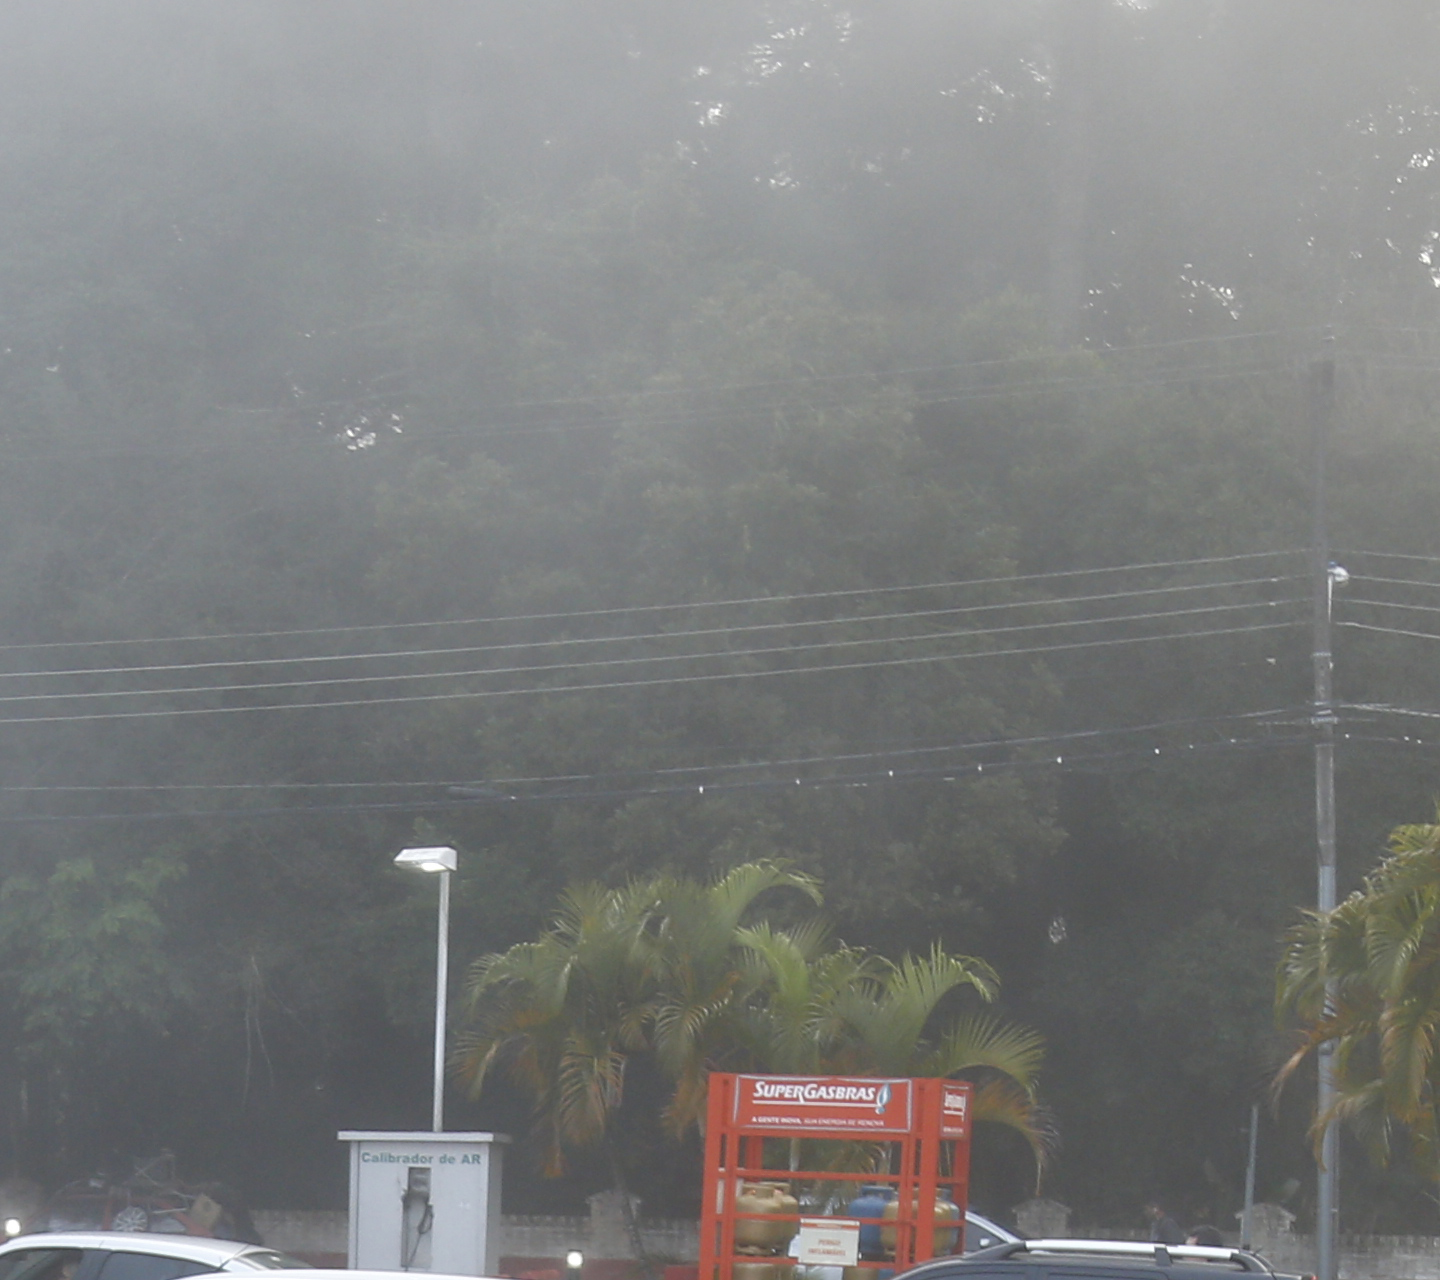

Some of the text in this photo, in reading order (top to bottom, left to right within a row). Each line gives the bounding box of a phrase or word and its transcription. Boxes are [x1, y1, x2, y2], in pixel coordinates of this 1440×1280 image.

[361, 1152, 481, 1164] Calibrador de AR
